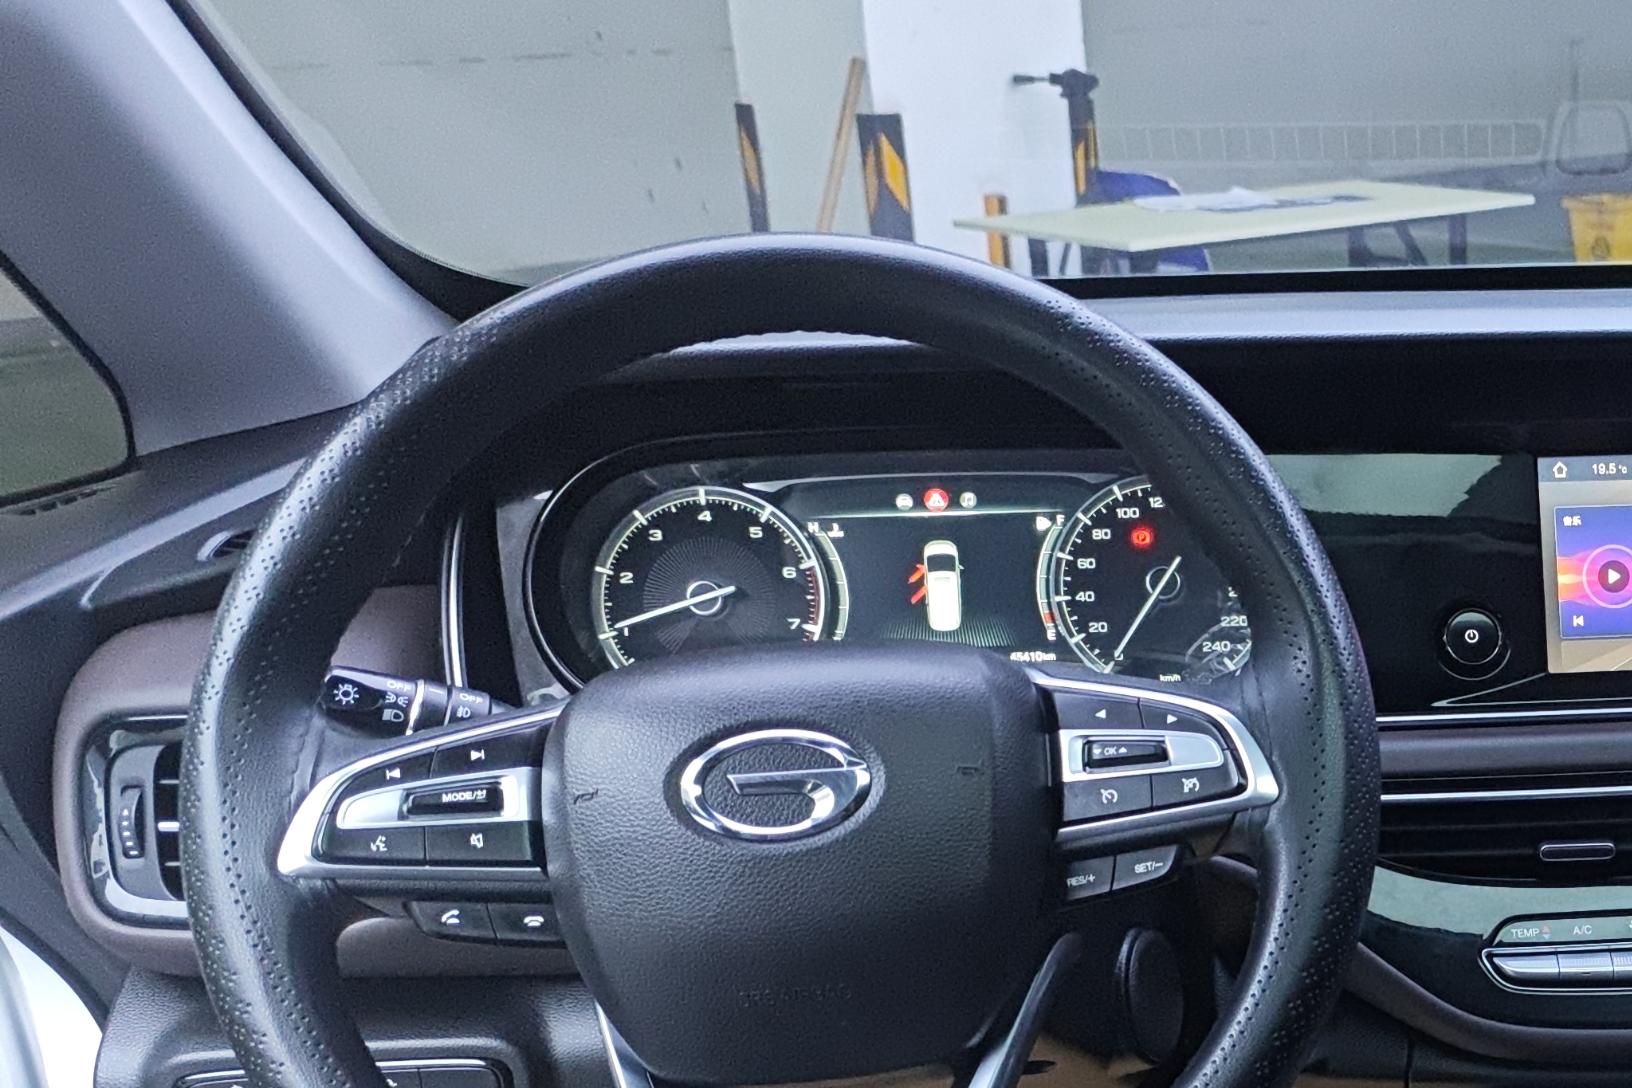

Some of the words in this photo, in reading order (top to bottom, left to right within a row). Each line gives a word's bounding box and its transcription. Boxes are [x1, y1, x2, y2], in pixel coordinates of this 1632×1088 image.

[1592, 463, 1617, 475] 19.5
[1148, 497, 1165, 508] 12
[697, 510, 712, 522] 4
[1115, 507, 1140, 519] 100
[648, 529, 663, 542] 3
[749, 526, 763, 538] 5
[1092, 528, 1111, 540] 80
[1077, 558, 1096, 569] 60
[619, 572, 634, 584] 2
[782, 567, 797, 579] 6
[1075, 591, 1095, 602] 40
[787, 618, 801, 631] 7
[1220, 615, 1248, 627] 220
[1088, 622, 1108, 633] 20
[1202, 640, 1231, 653] 240
[387, 682, 411, 692] OFF
[460, 693, 483, 703] OFF
[1104, 746, 1117, 756] OK
[1511, 928, 1540, 938] TEMP
[1572, 925, 1592, 935] A/C
